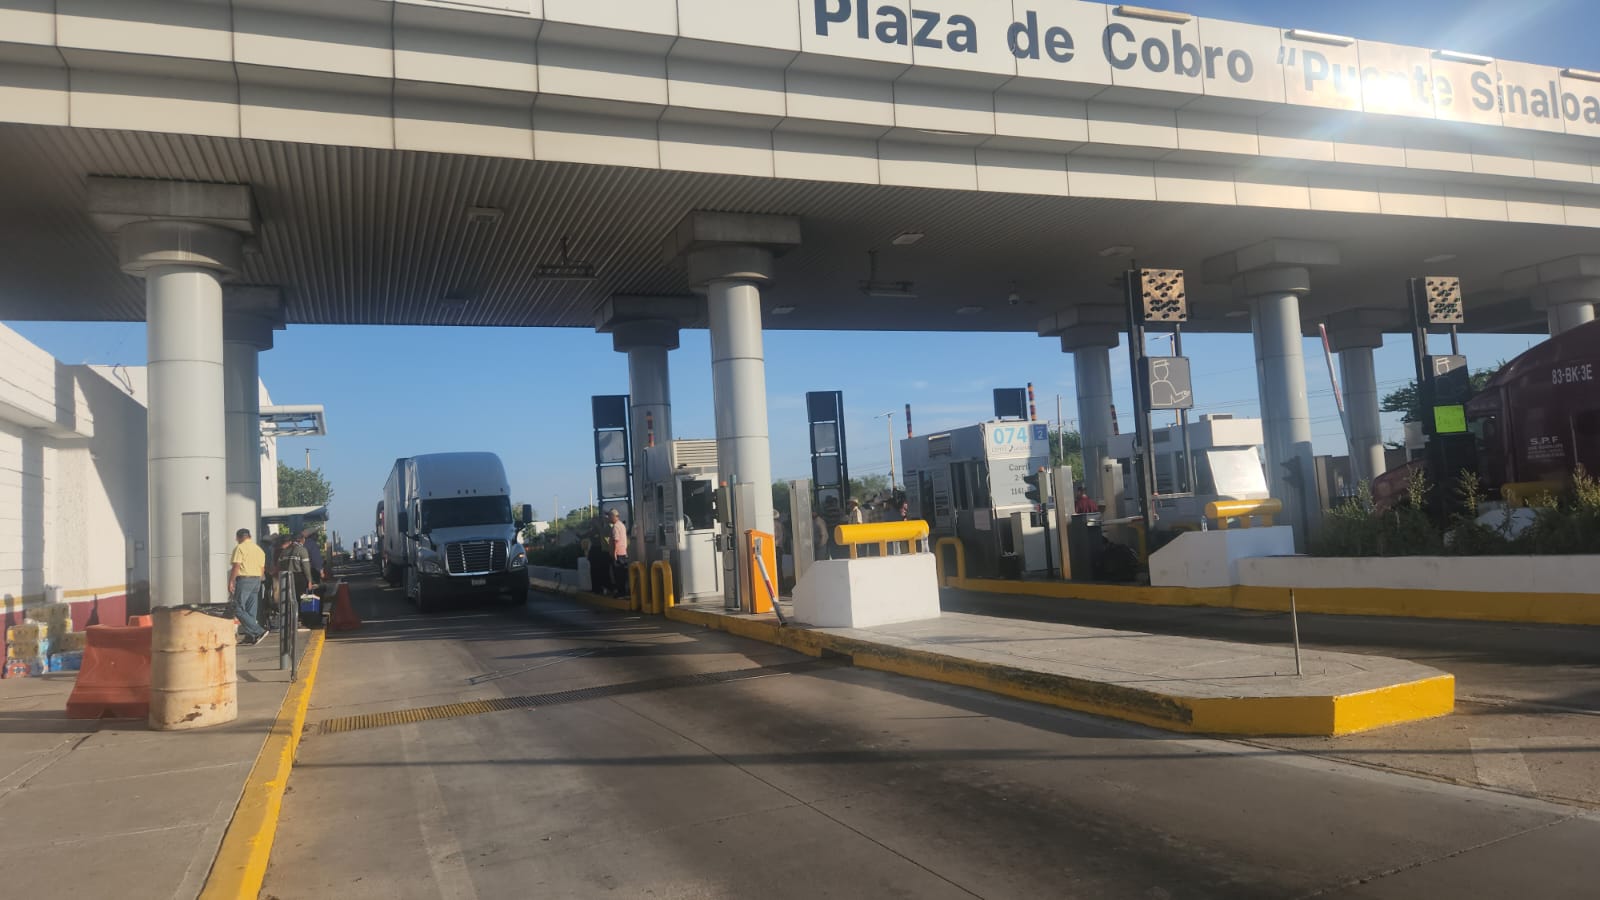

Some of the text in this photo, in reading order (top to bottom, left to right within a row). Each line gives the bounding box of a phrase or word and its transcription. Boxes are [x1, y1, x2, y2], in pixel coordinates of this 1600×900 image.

[814, 0, 978, 53] Plaza
[1006, 11, 1075, 63] de
[1101, 23, 1254, 83] Cobro
[1470, 71, 1600, 125] Sinaloa
[1552, 363, 1593, 385] 83-BK-3E
[993, 428, 1028, 445] 074
[1038, 430, 1044, 439] 2
